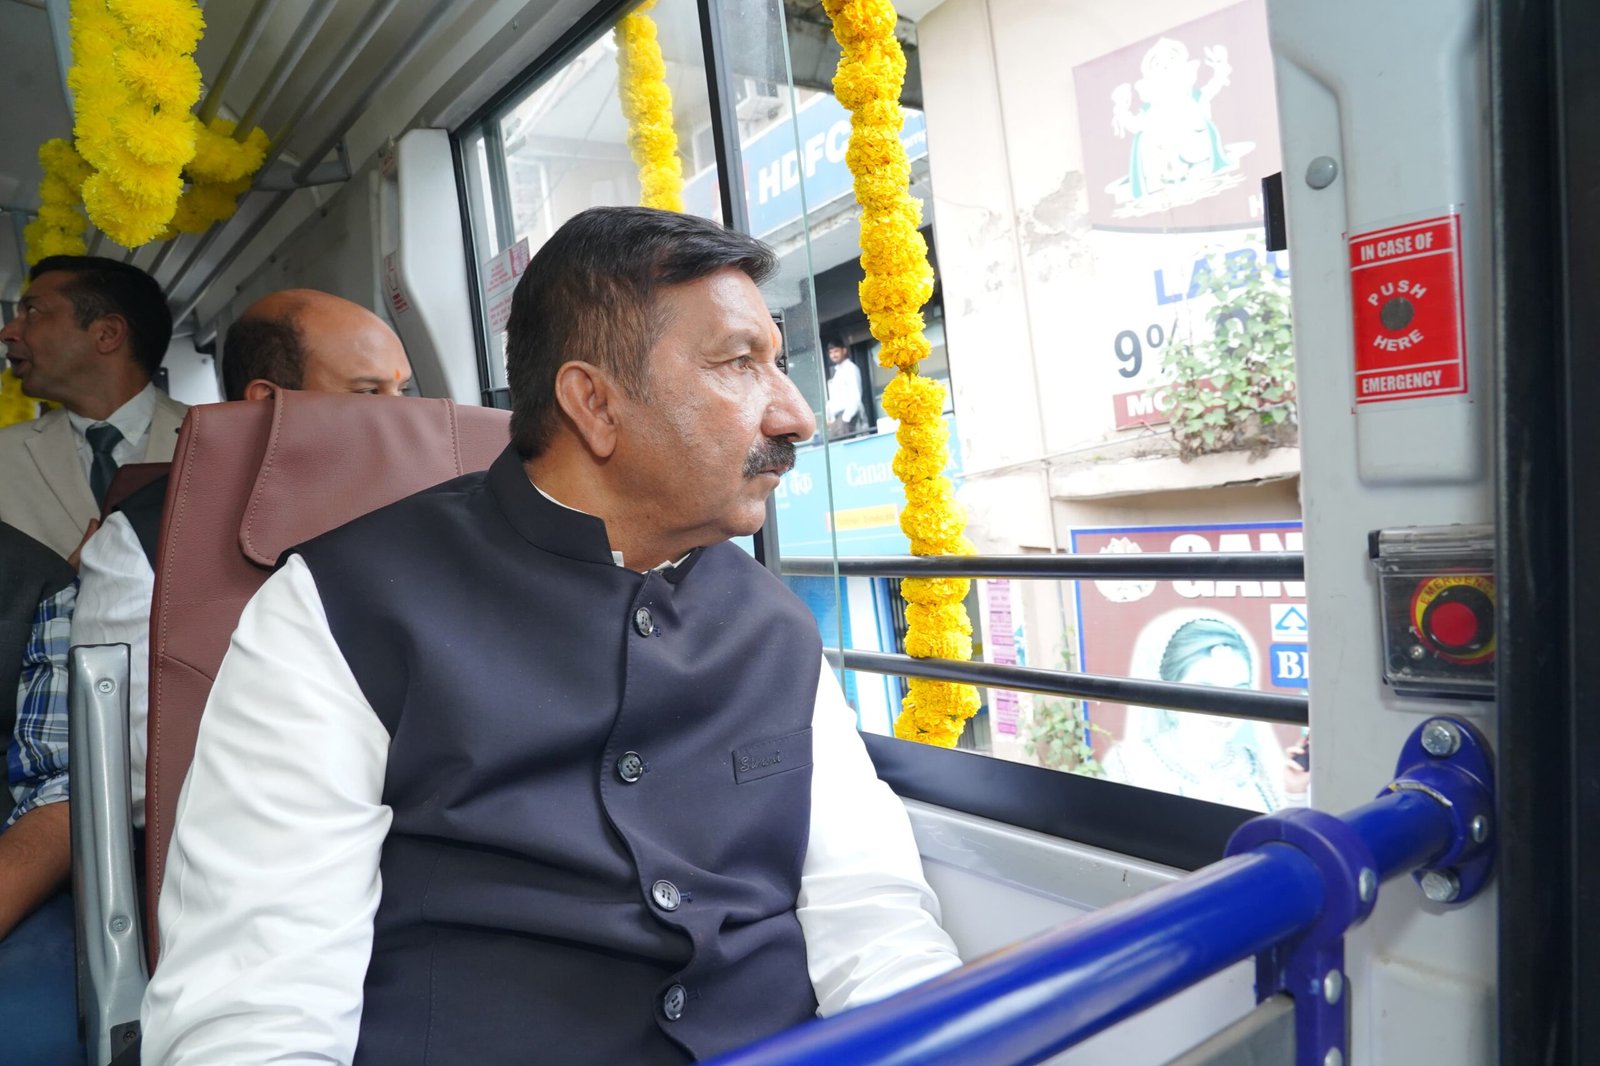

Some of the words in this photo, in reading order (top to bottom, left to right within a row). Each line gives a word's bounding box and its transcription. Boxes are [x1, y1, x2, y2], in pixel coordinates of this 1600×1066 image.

[758, 120, 850, 205] HDFC
[1361, 245, 1375, 262] IN
[1377, 236, 1411, 257] CASE
[1415, 232, 1434, 250] OF
[1367, 279, 1428, 306] PUSH
[1373, 329, 1424, 351] HERE
[1362, 370, 1443, 394] EMERGENCY
[845, 461, 894, 487] Canar
